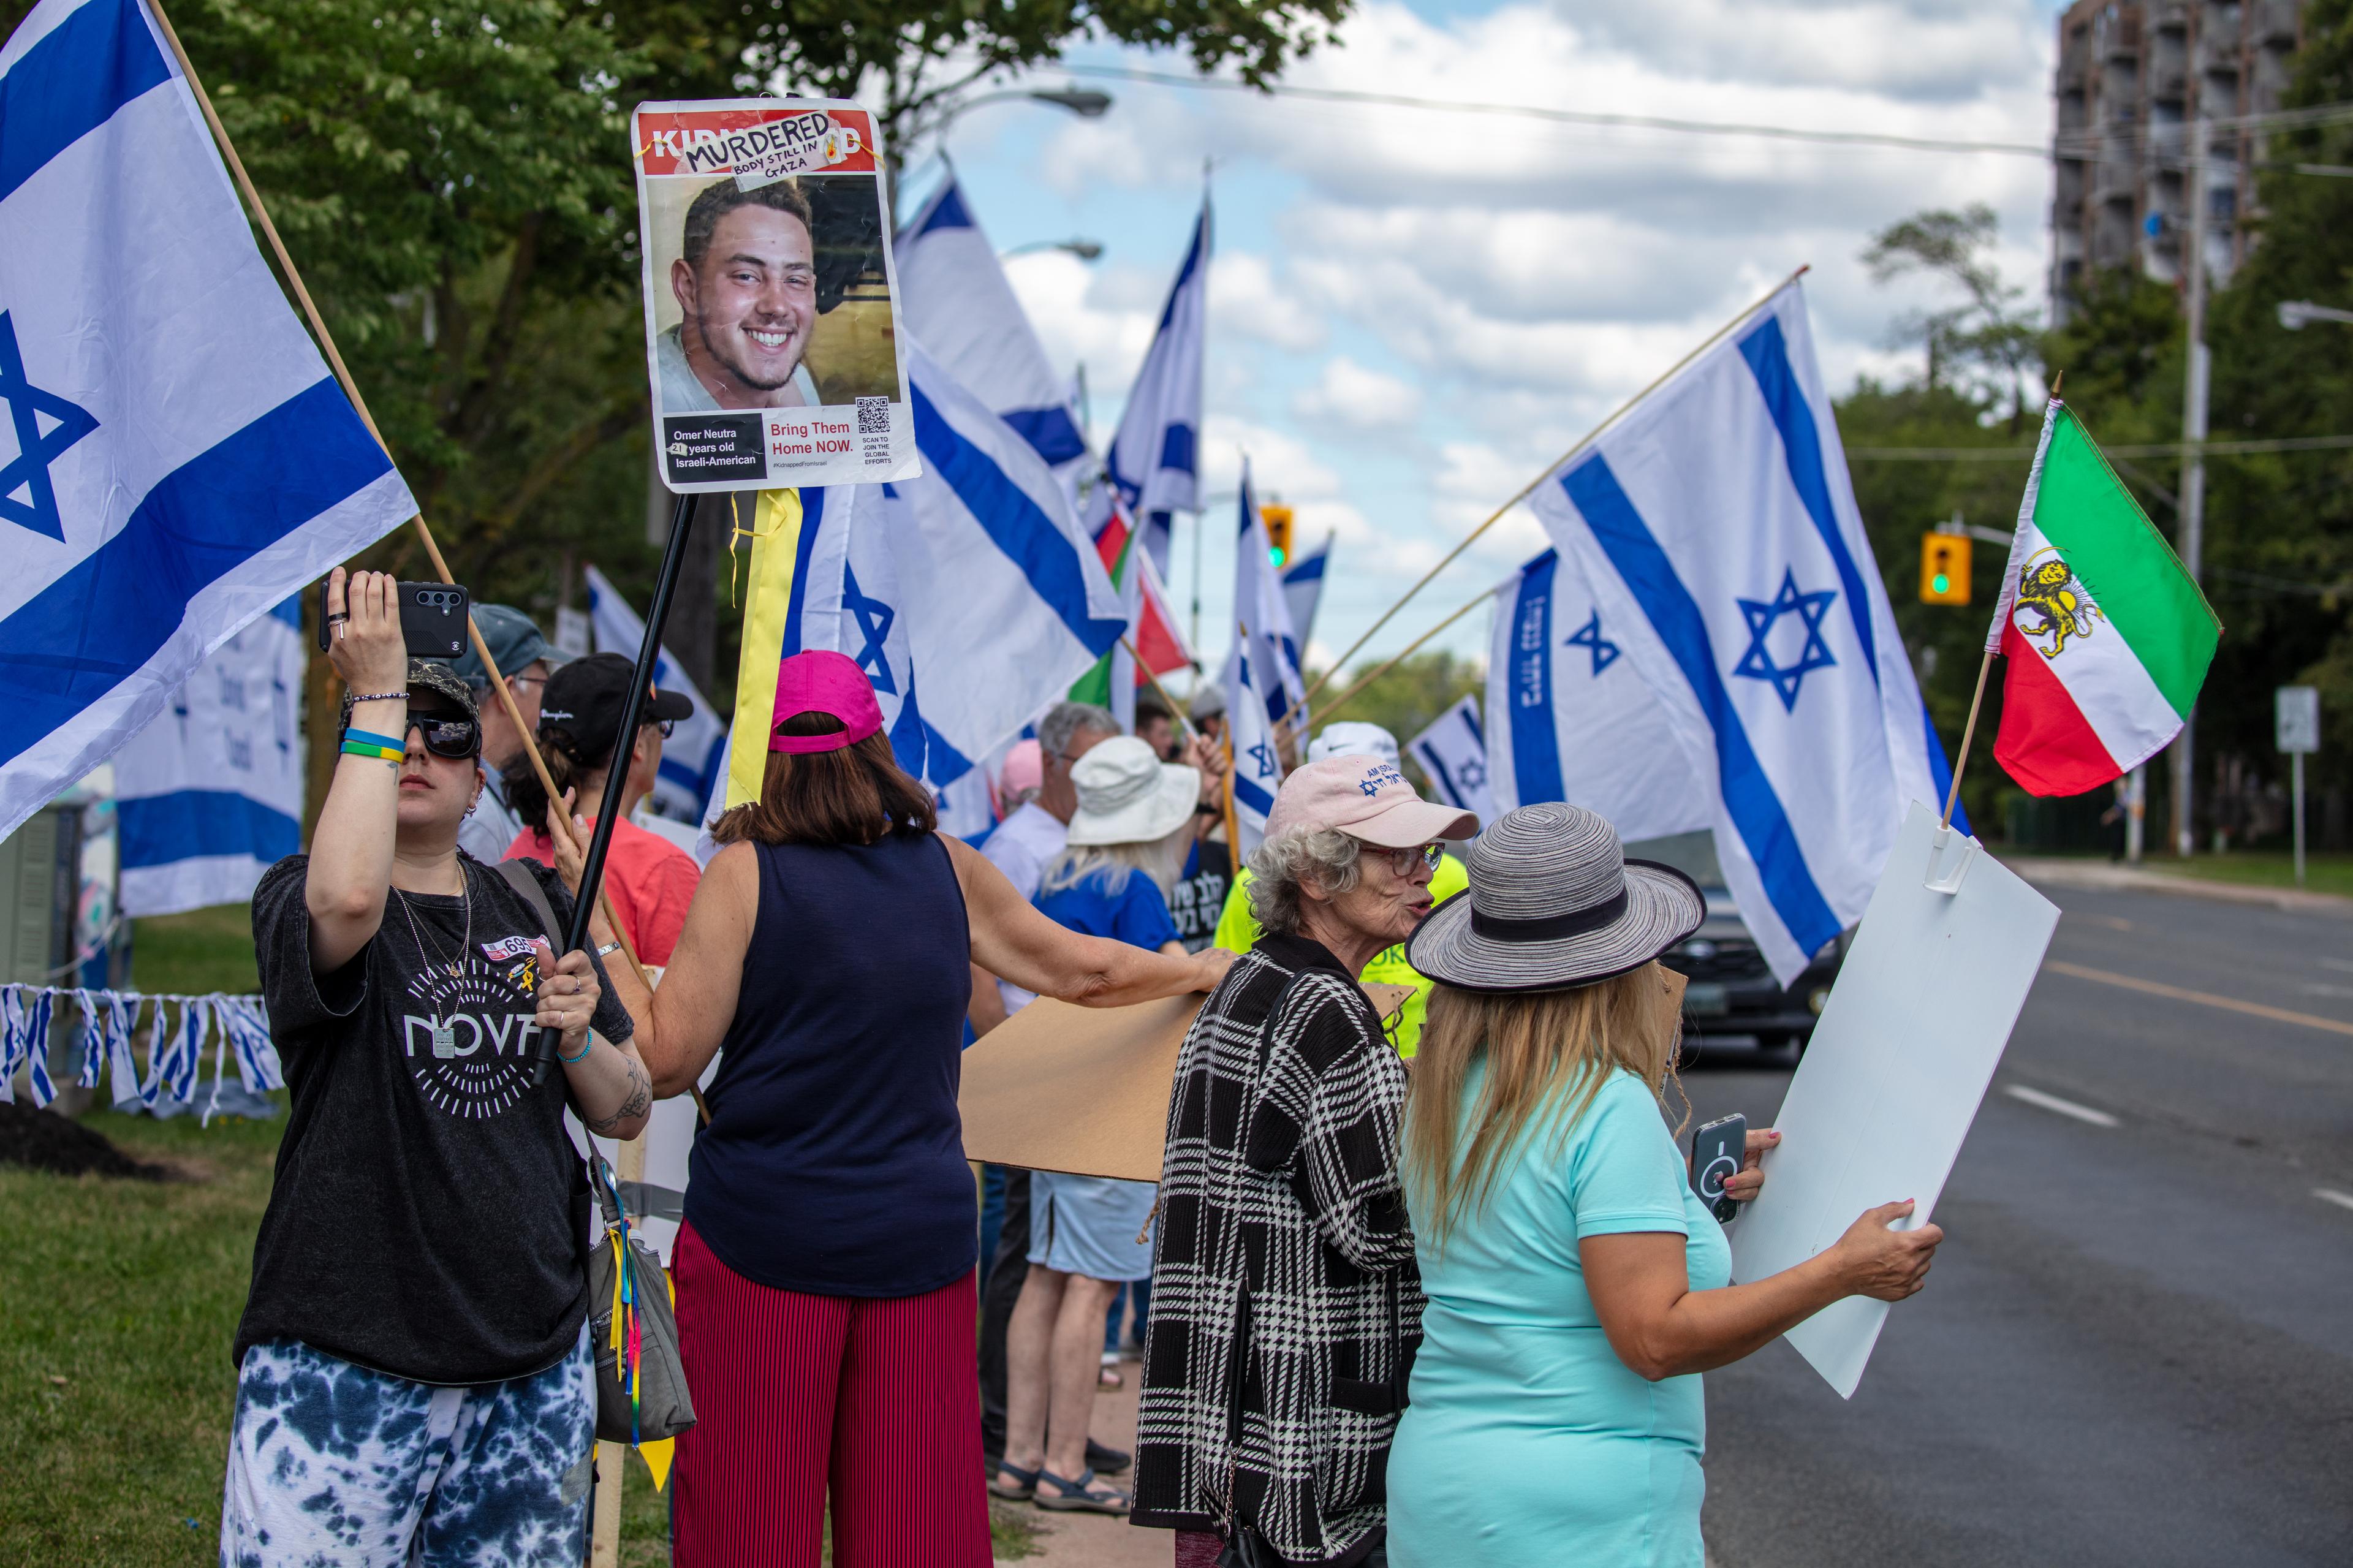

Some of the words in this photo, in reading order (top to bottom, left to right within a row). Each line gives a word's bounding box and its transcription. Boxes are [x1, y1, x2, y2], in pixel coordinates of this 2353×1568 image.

[686, 113, 829, 172] MURDERED
[734, 158, 764, 175] BODY
[767, 148, 800, 164] STILL
[803, 140, 817, 153] IN
[765, 157, 807, 178] GAZA
[674, 431, 702, 440] Omer
[704, 430, 737, 439] Neutra
[771, 423, 808, 437] Bring
[811, 422, 849, 434] Them
[689, 444, 716, 455] years
[719, 442, 735, 452] old
[773, 443, 813, 455] Home
[816, 440, 854, 453] NOW.
[676, 455, 756, 468] Israeli-American
[1367, 767, 1380, 778] AM
[504, 937, 532, 953] 695
